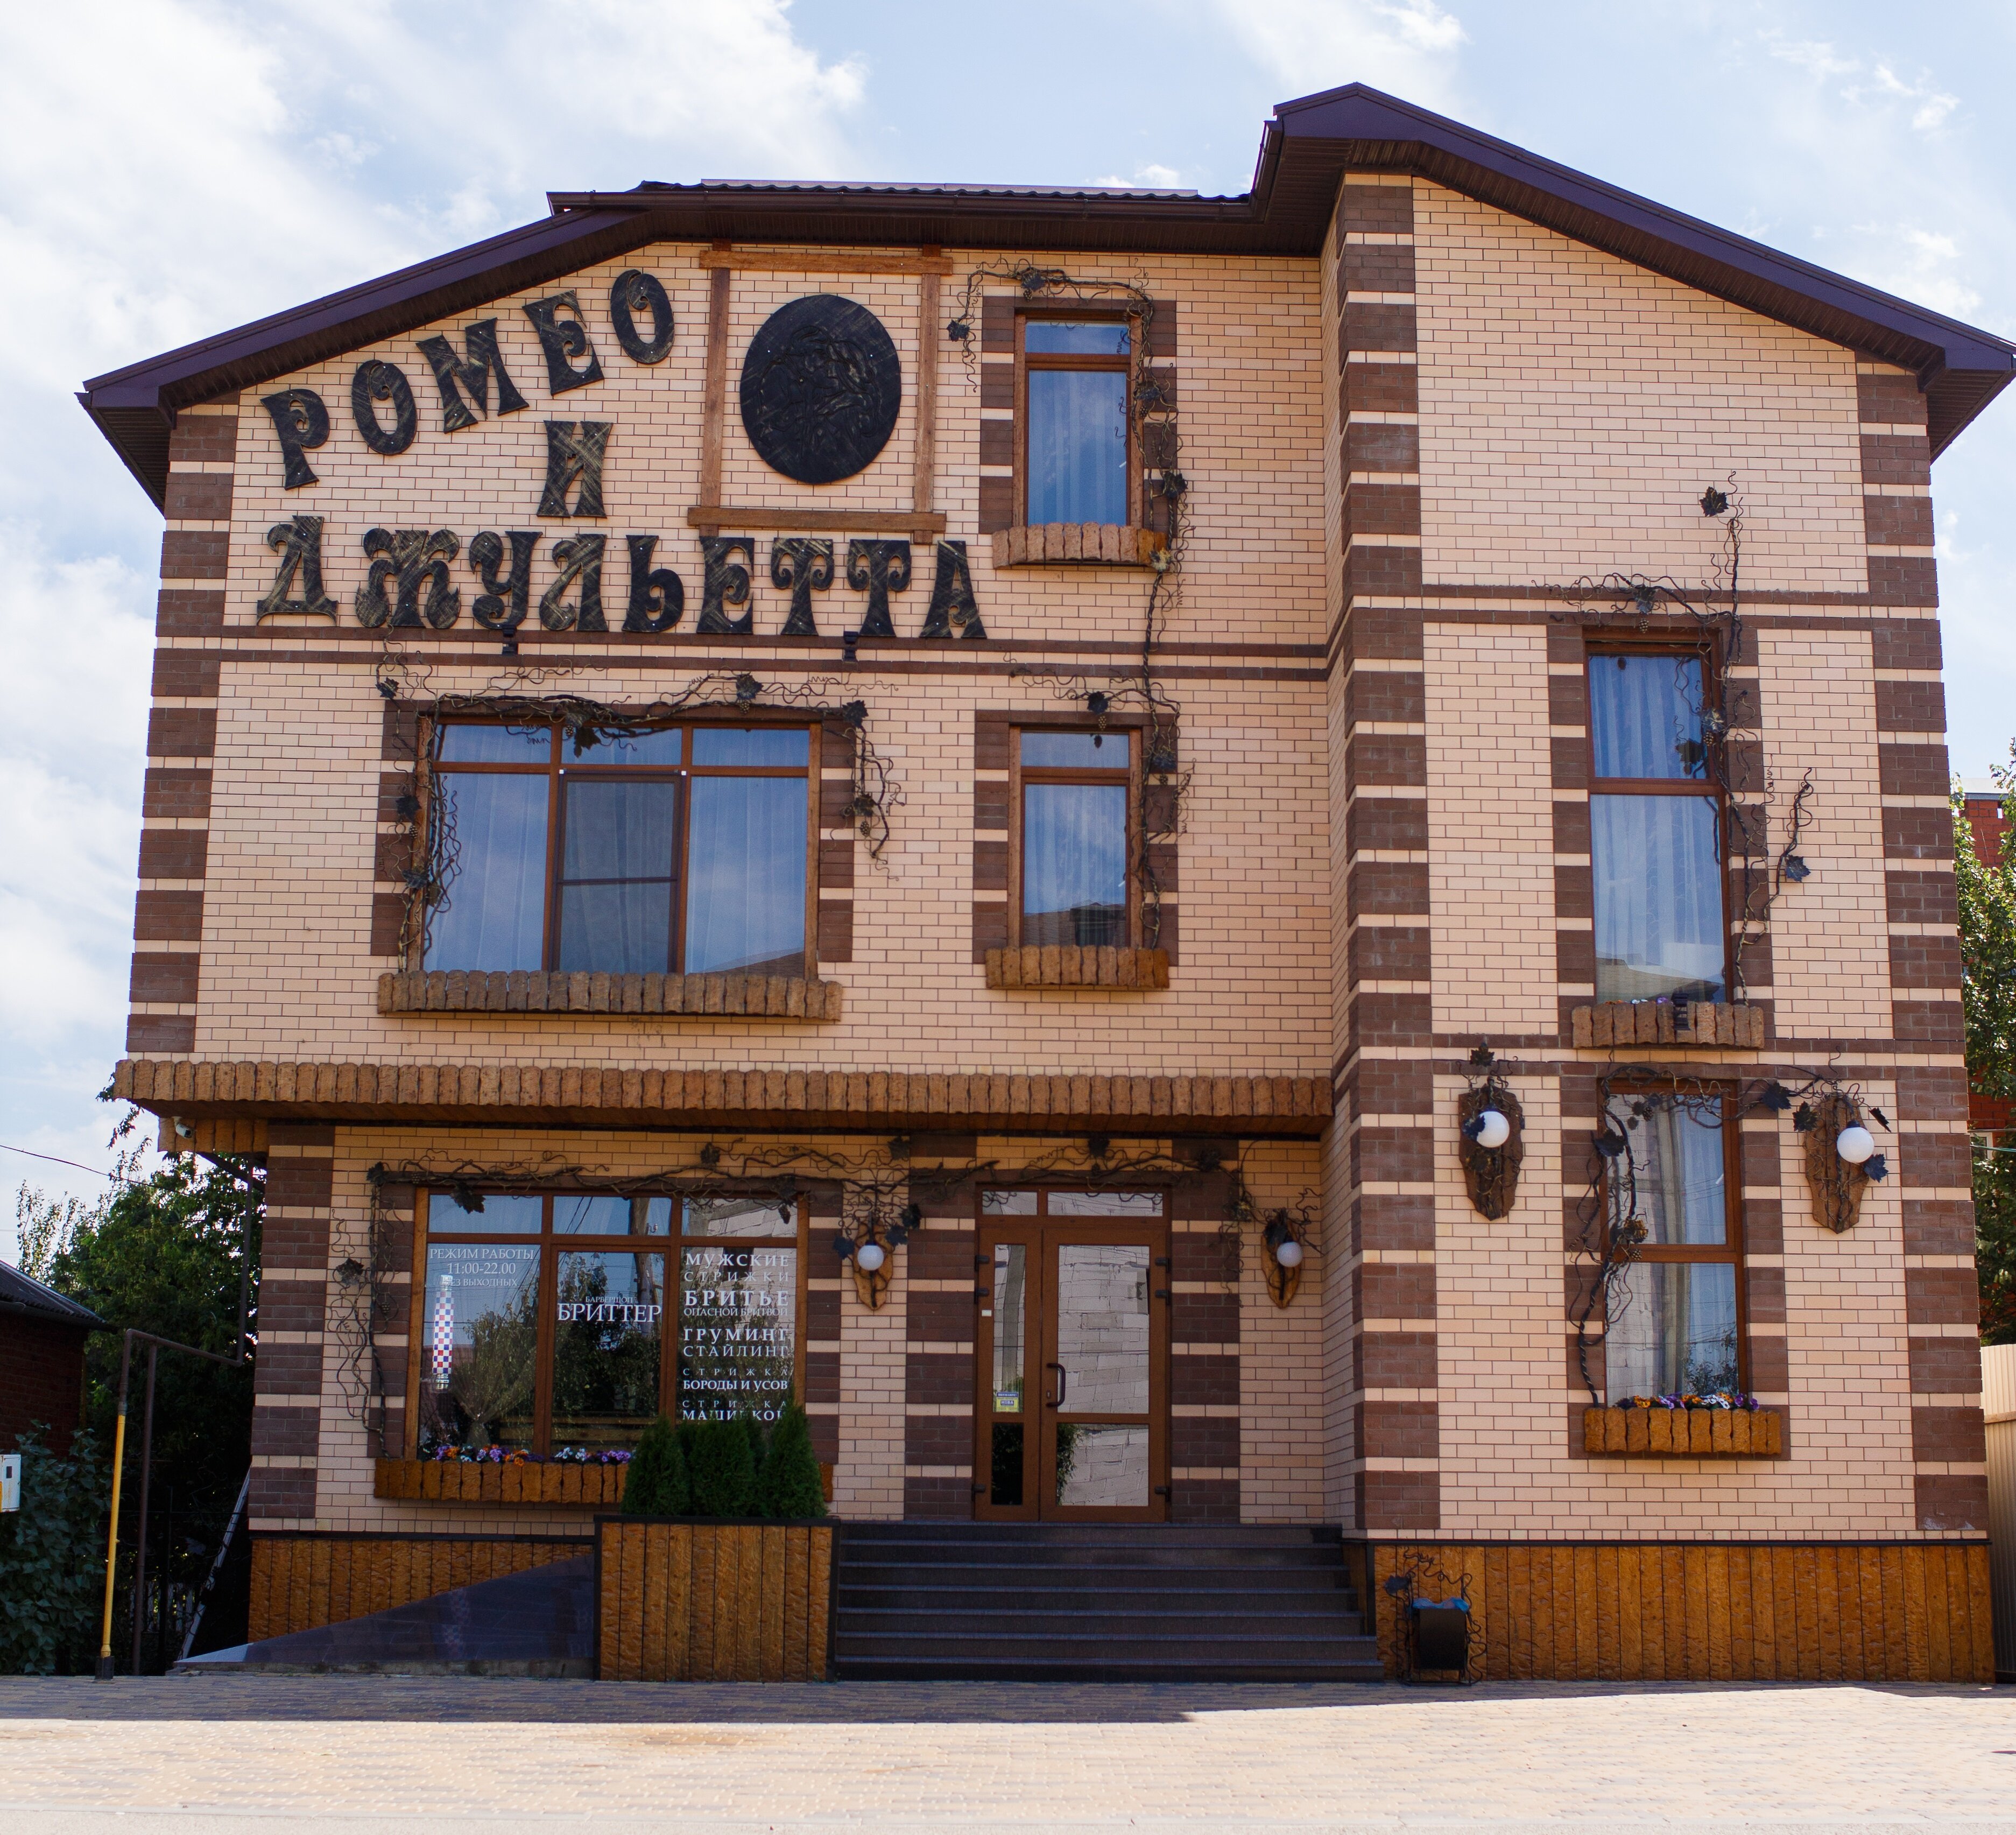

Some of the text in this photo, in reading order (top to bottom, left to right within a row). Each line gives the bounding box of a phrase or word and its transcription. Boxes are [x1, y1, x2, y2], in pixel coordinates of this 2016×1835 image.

[260, 269, 675, 490] РОМЕО
[538, 420, 613, 518] И
[257, 515, 987, 639] ДЖУЛЬЕТТА
[430, 1248, 534, 1260] РЕЖИМ РАБОТЫ
[686, 1253, 789, 1269] МУЖСКИЕ
[447, 1262, 516, 1274] 11:00-22.00
[463, 1278, 518, 1287] ВЫХОДНЫХ
[684, 1271, 788, 1282] СТРИЖКИ
[685, 1290, 788, 1306] БРИТЬЕ
[557, 1303, 662, 1323] БРИТТЕР
[683, 1306, 787, 1317] ОПАСНОЙ БРИТВОЙ
[683, 1328, 788, 1344] ГРУМИНГ
[683, 1344, 788, 1357] СТАЙЛИНГ
[683, 1368, 788, 1376] СТРИЖКА
[683, 1380, 788, 1392] БОРОДЫ И УСОВ
